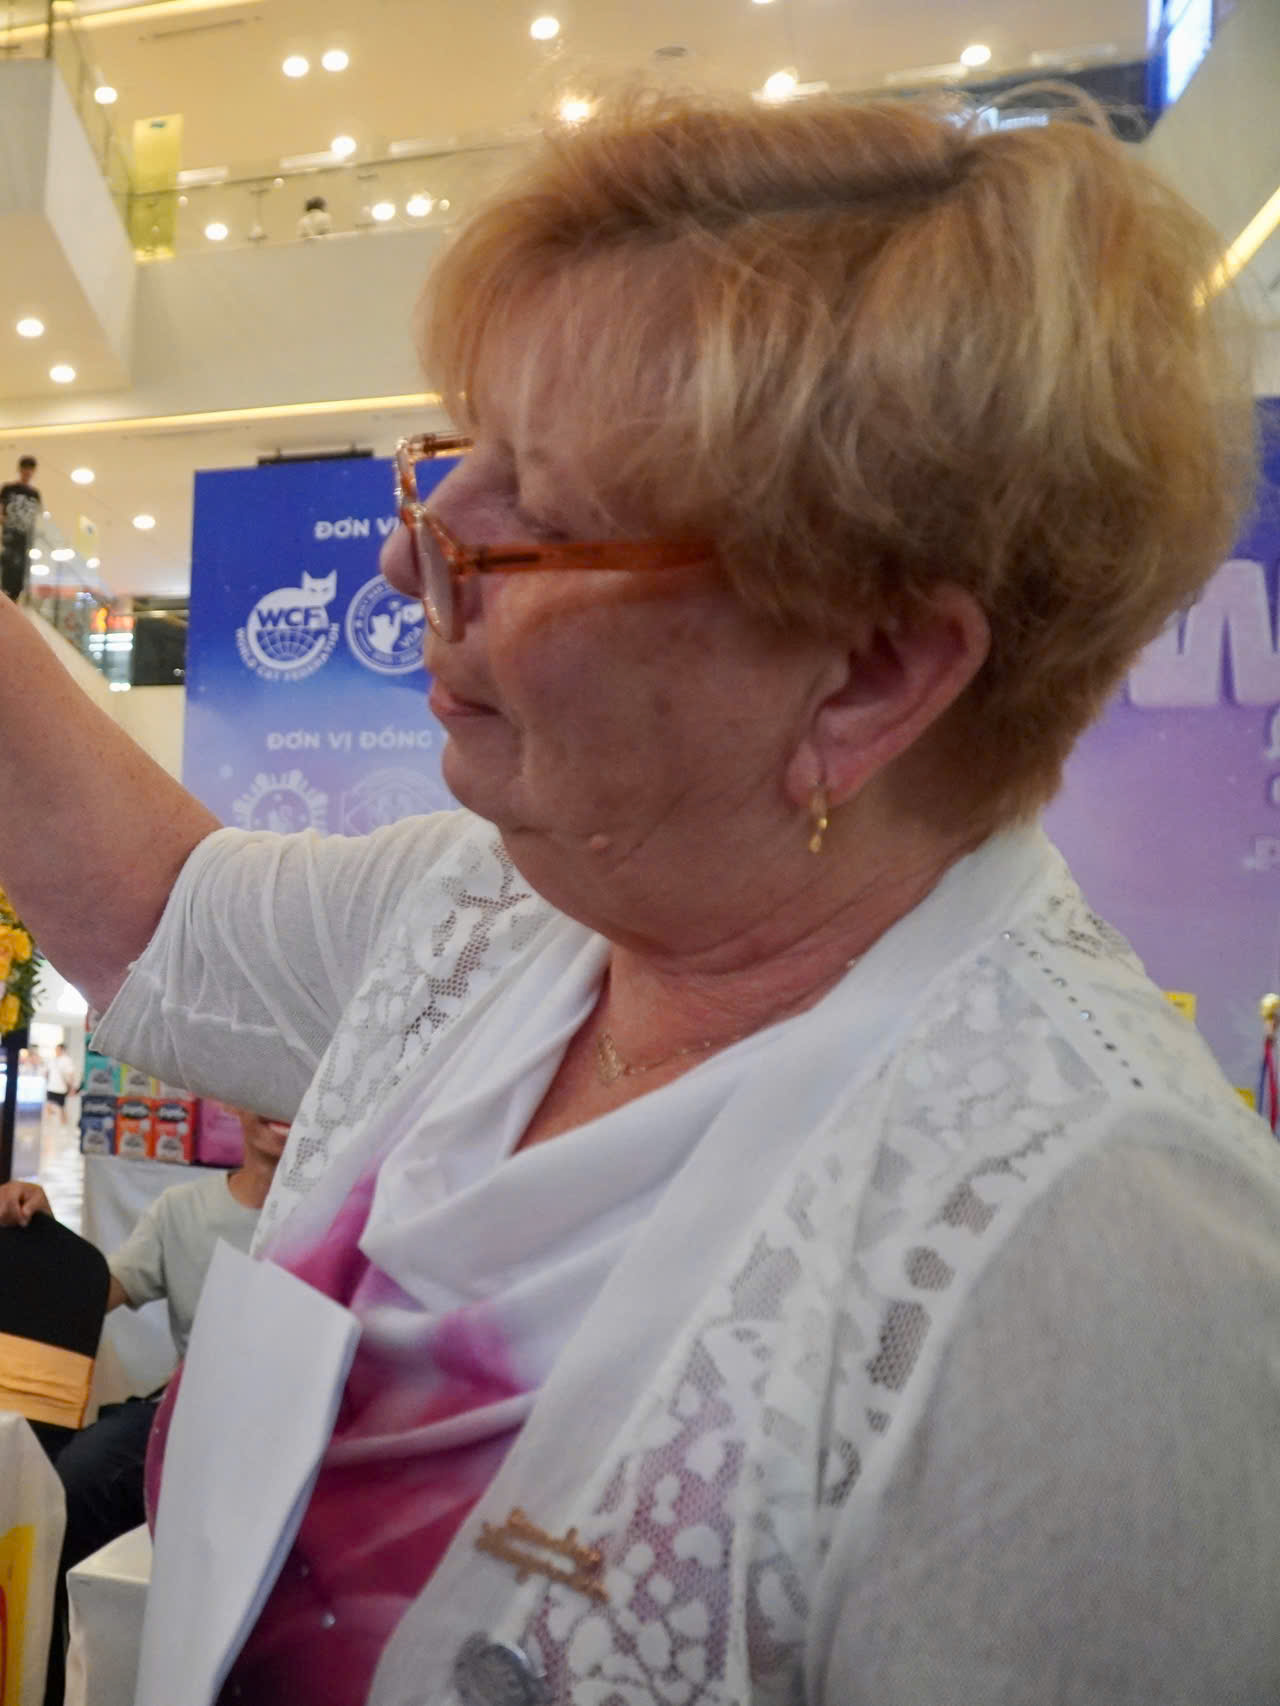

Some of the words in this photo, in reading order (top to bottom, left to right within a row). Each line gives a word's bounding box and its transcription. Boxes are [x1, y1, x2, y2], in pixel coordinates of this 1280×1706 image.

[314, 516, 370, 541] ĐƠN
[257, 607, 321, 626] WCF
[267, 730, 320, 750] ĐƠN
